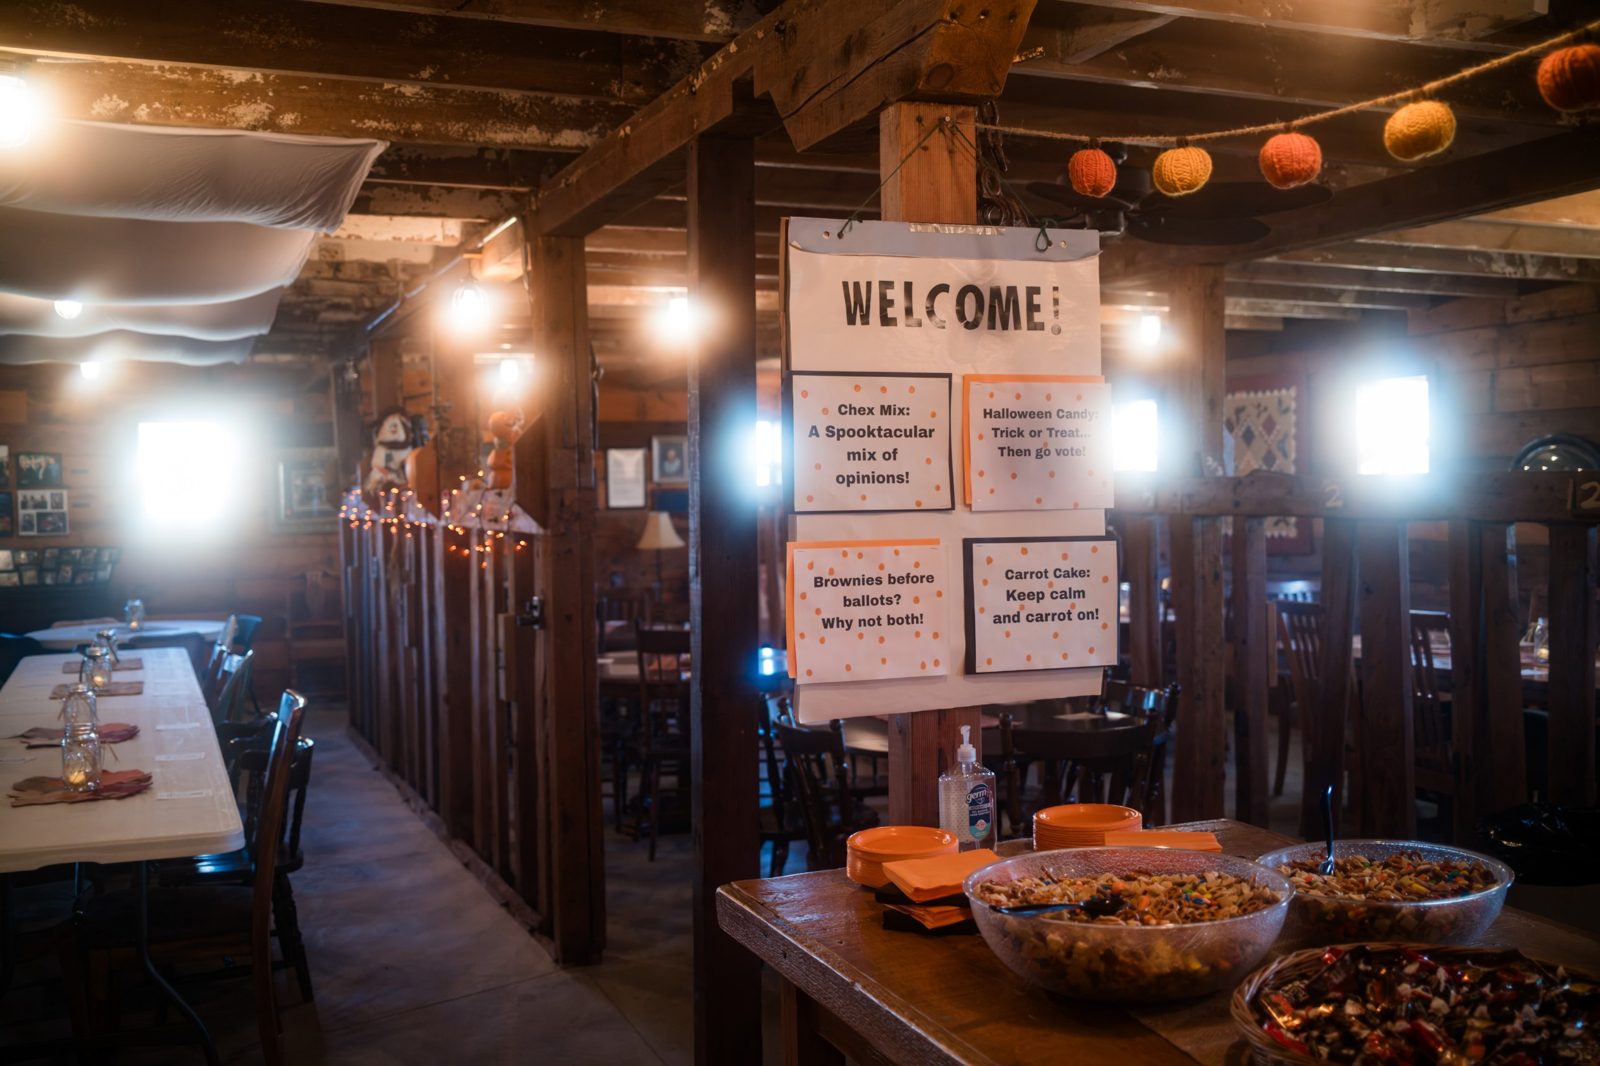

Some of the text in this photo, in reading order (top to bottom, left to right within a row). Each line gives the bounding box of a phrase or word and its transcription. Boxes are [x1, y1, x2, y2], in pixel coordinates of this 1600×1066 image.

[842, 280, 1062, 336] WELCOME!
[837, 404, 911, 416] Chex Mix:
[983, 408, 1099, 421] Halloween Candy:
[808, 425, 935, 442] A Spooktacular
[991, 427, 1025, 438] Trick
[1029, 429, 1043, 438] or
[846, 448, 898, 462] mix of
[998, 446, 1086, 460] Then go vote!
[835, 471, 910, 488] opinions!
[813, 572, 935, 588] Brownies before
[1005, 567, 1091, 580] Carrot Cake:
[842, 593, 902, 608] ballots?
[1006, 588, 1086, 604] Keep calm
[822, 613, 924, 631] Why not both!
[993, 608, 1100, 624] and carrot on!
